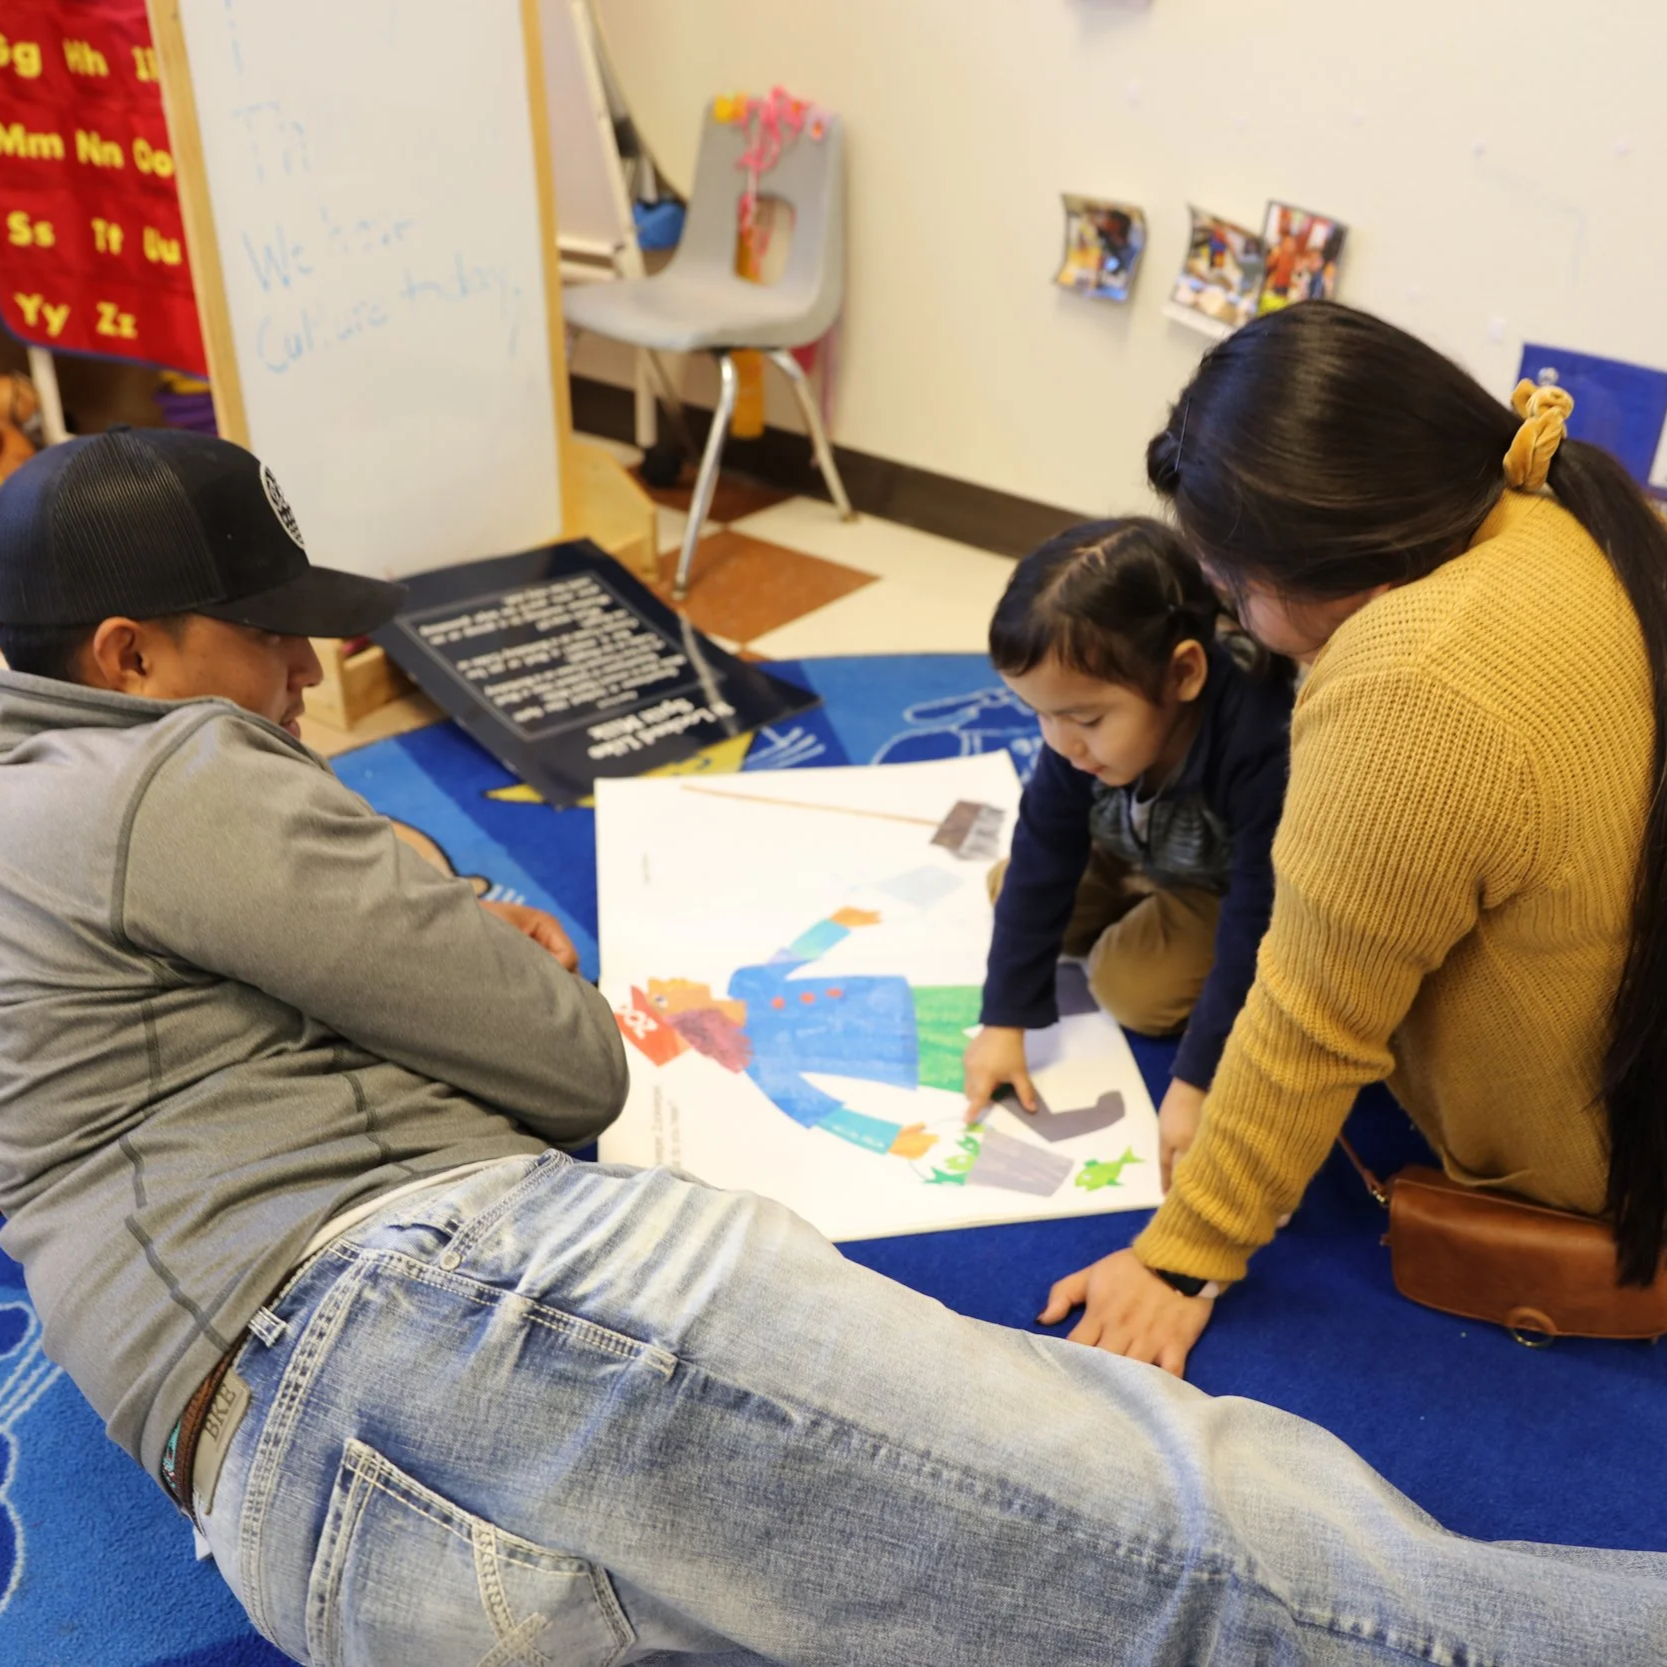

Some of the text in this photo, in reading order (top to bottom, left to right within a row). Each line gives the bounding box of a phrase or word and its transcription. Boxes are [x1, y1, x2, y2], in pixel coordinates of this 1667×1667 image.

[0, 123, 174, 177] Mm Nn Oo
[7, 211, 54, 247] Ss
[144, 226, 184, 265] Uu
[241, 221, 316, 293] We
[15, 294, 136, 338] Yy Zz
[205, 1383, 236, 1441] BKE
